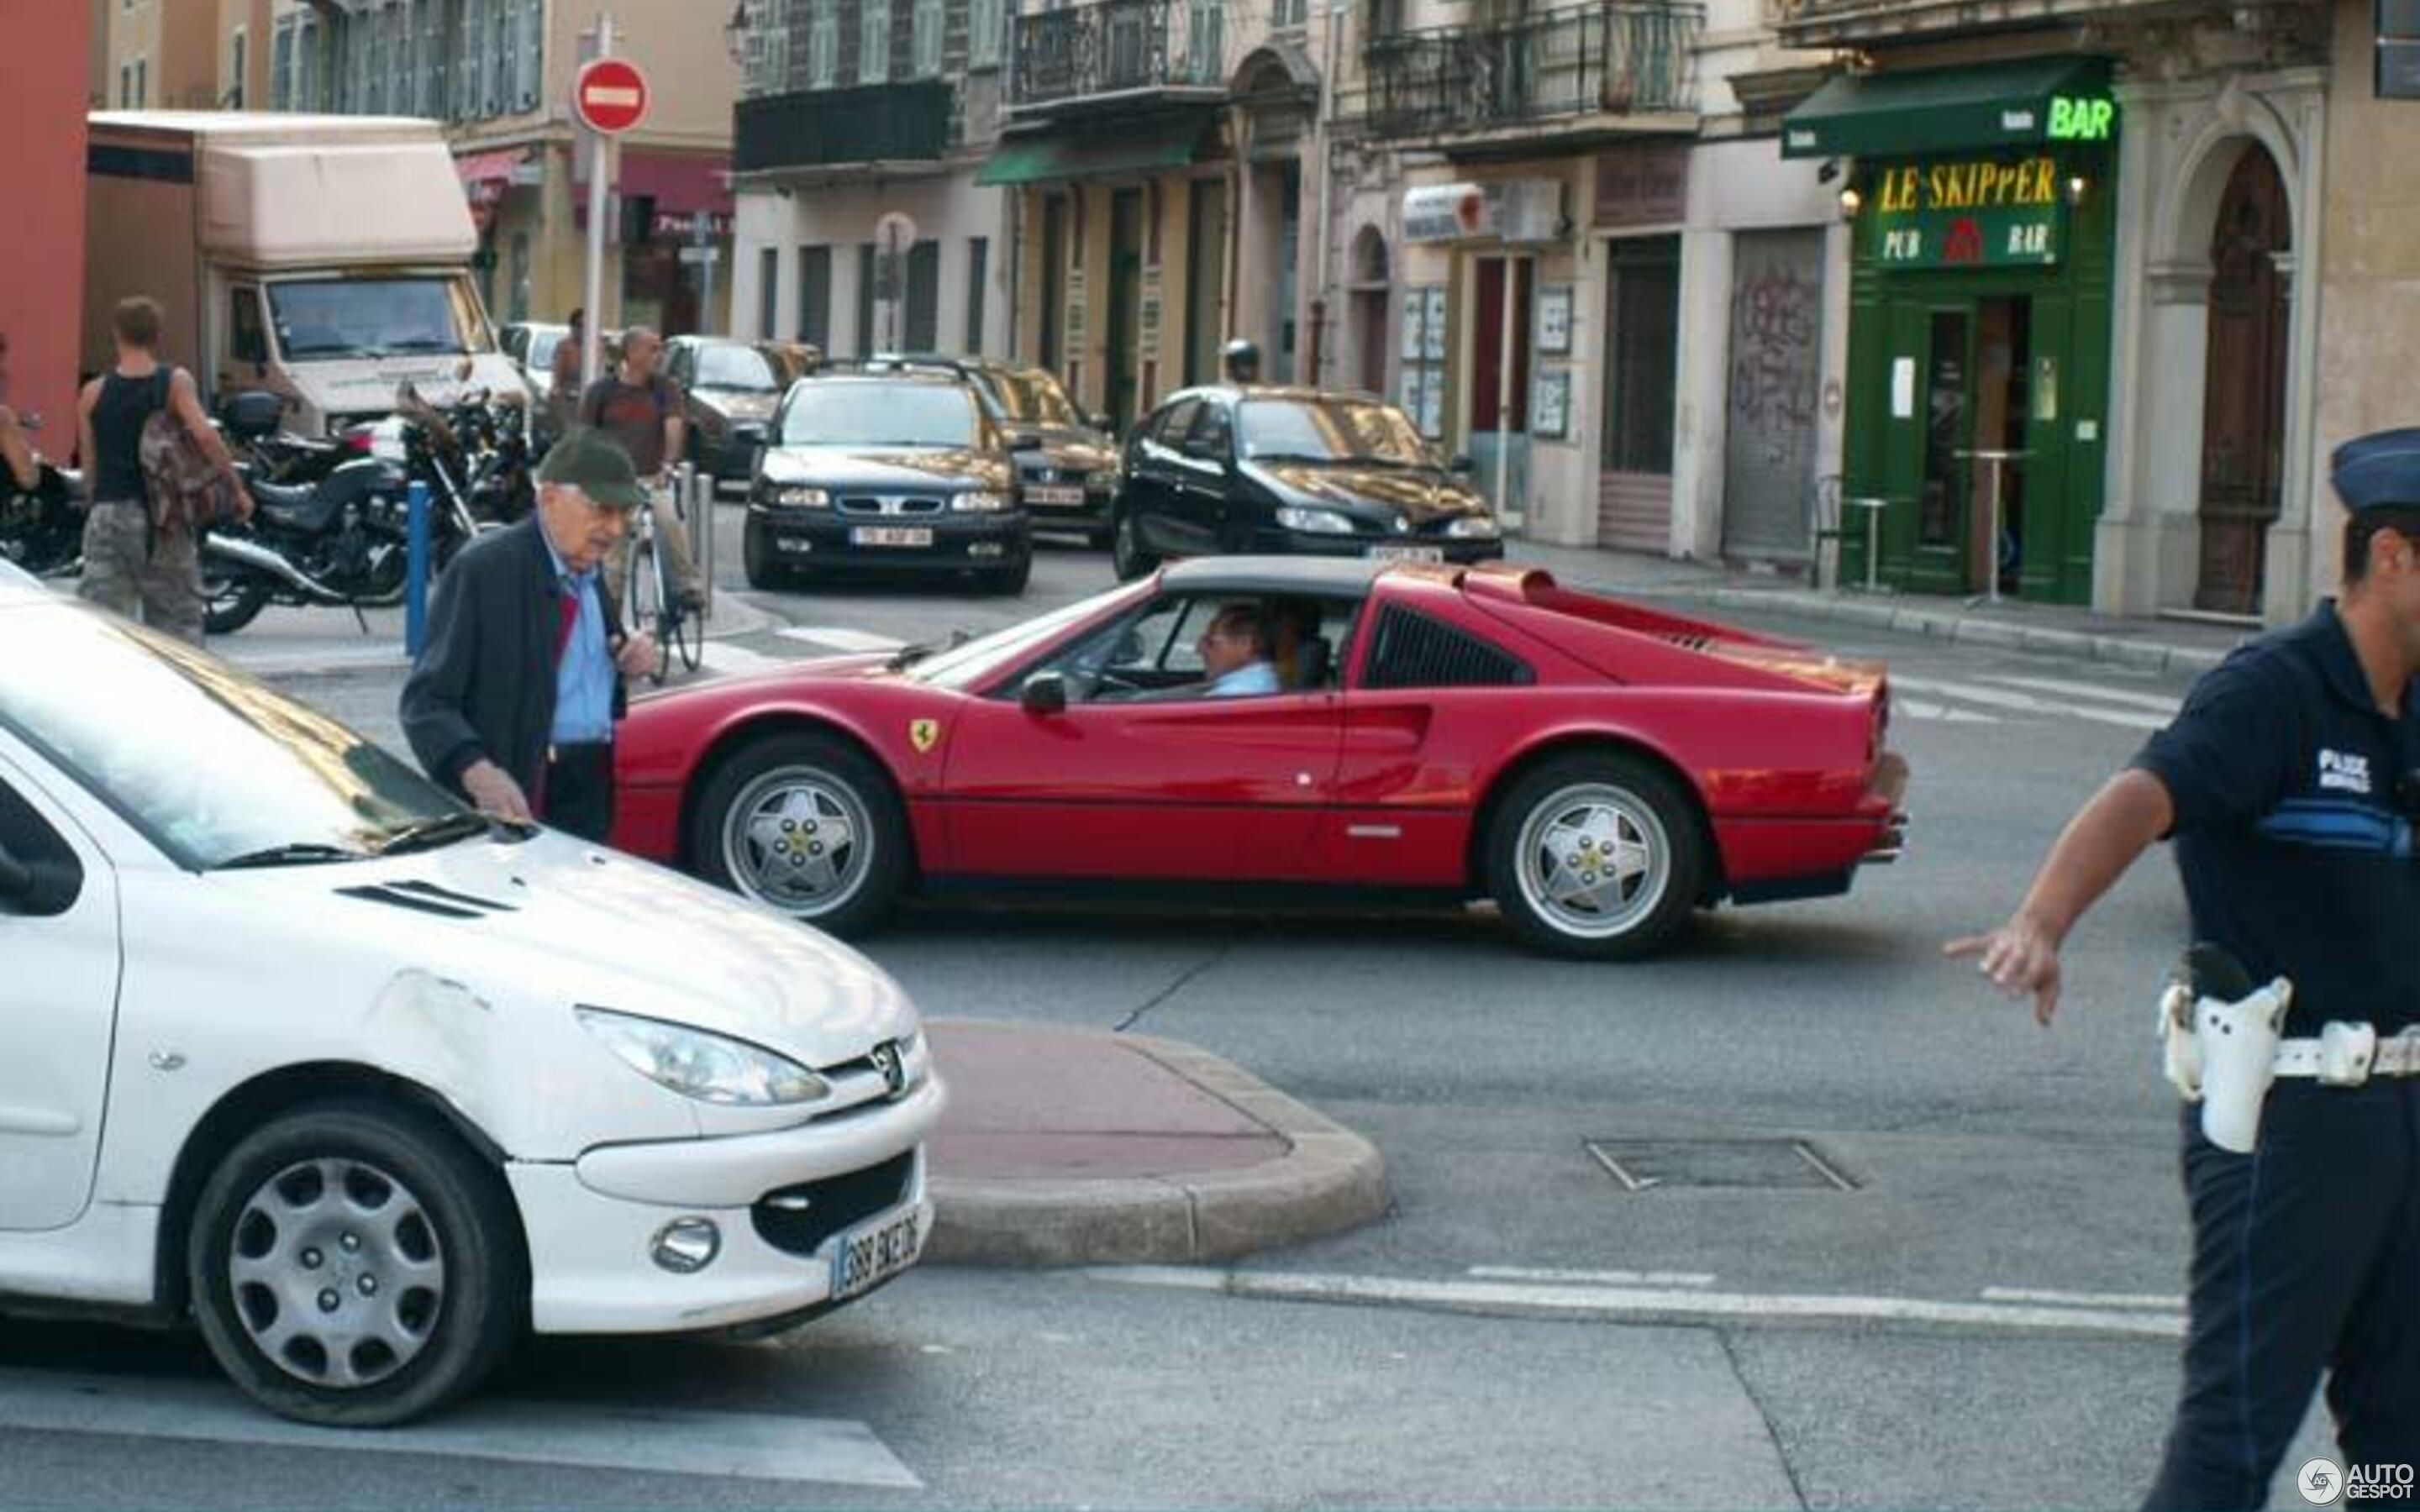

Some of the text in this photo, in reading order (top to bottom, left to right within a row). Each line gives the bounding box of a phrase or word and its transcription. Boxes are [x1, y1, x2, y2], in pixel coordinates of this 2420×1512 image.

[2047, 96, 2112, 139] BAR
[1881, 158, 2055, 212] LE SKIPPER
[2008, 223, 2049, 255] BAR
